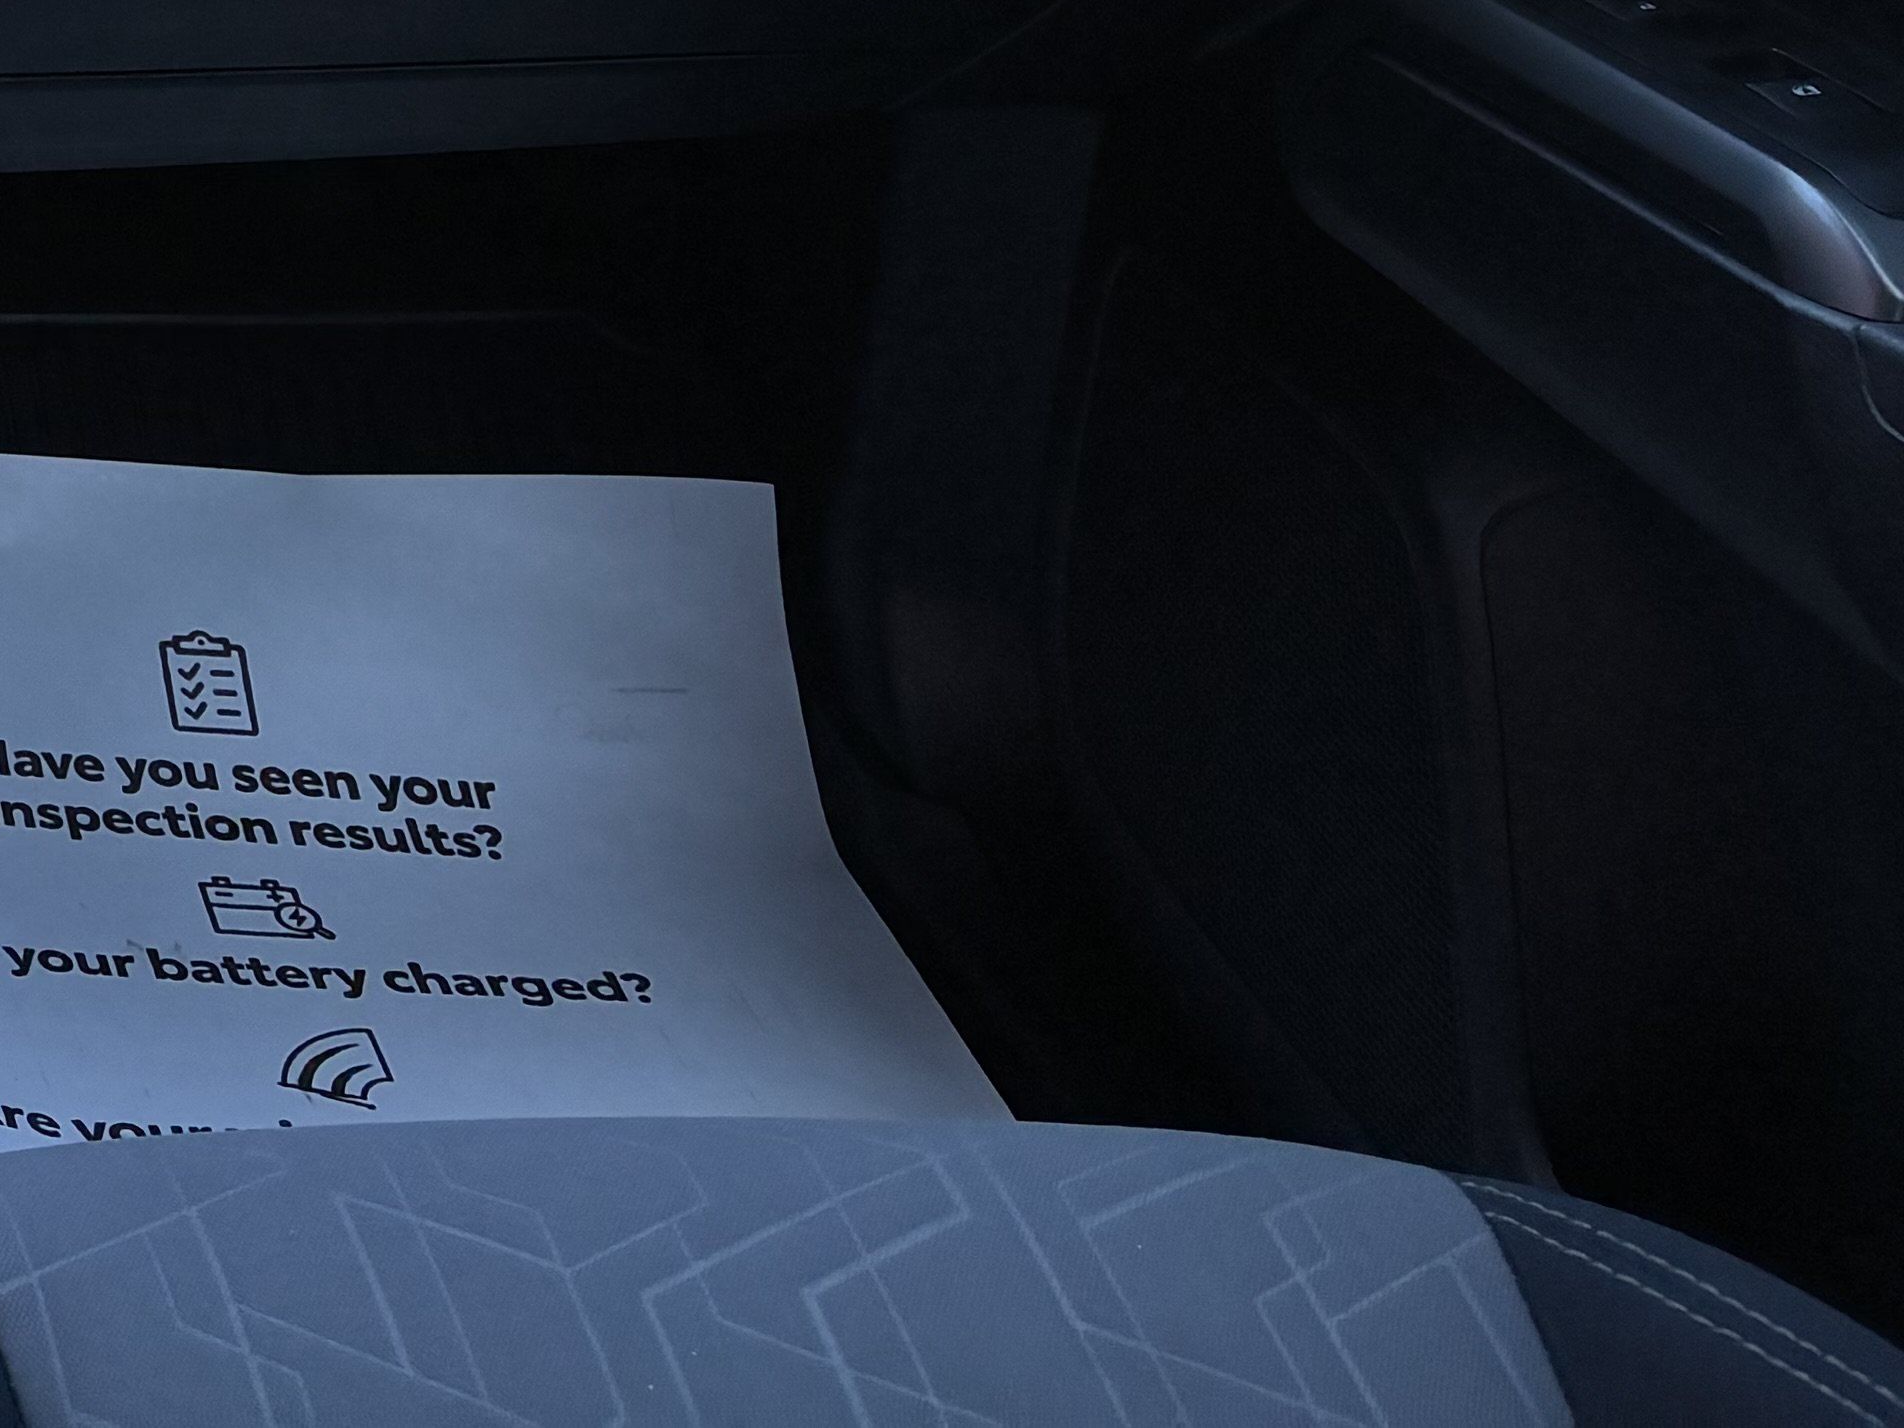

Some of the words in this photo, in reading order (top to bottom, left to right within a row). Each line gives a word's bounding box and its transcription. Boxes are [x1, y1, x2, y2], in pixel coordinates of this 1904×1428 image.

[114, 747, 218, 795] you
[230, 761, 362, 802] seen
[367, 770, 497, 814] your
[287, 815, 504, 861] results?
[0, 937, 137, 981] your
[145, 944, 367, 1002] battery
[380, 958, 655, 1009] charged?
